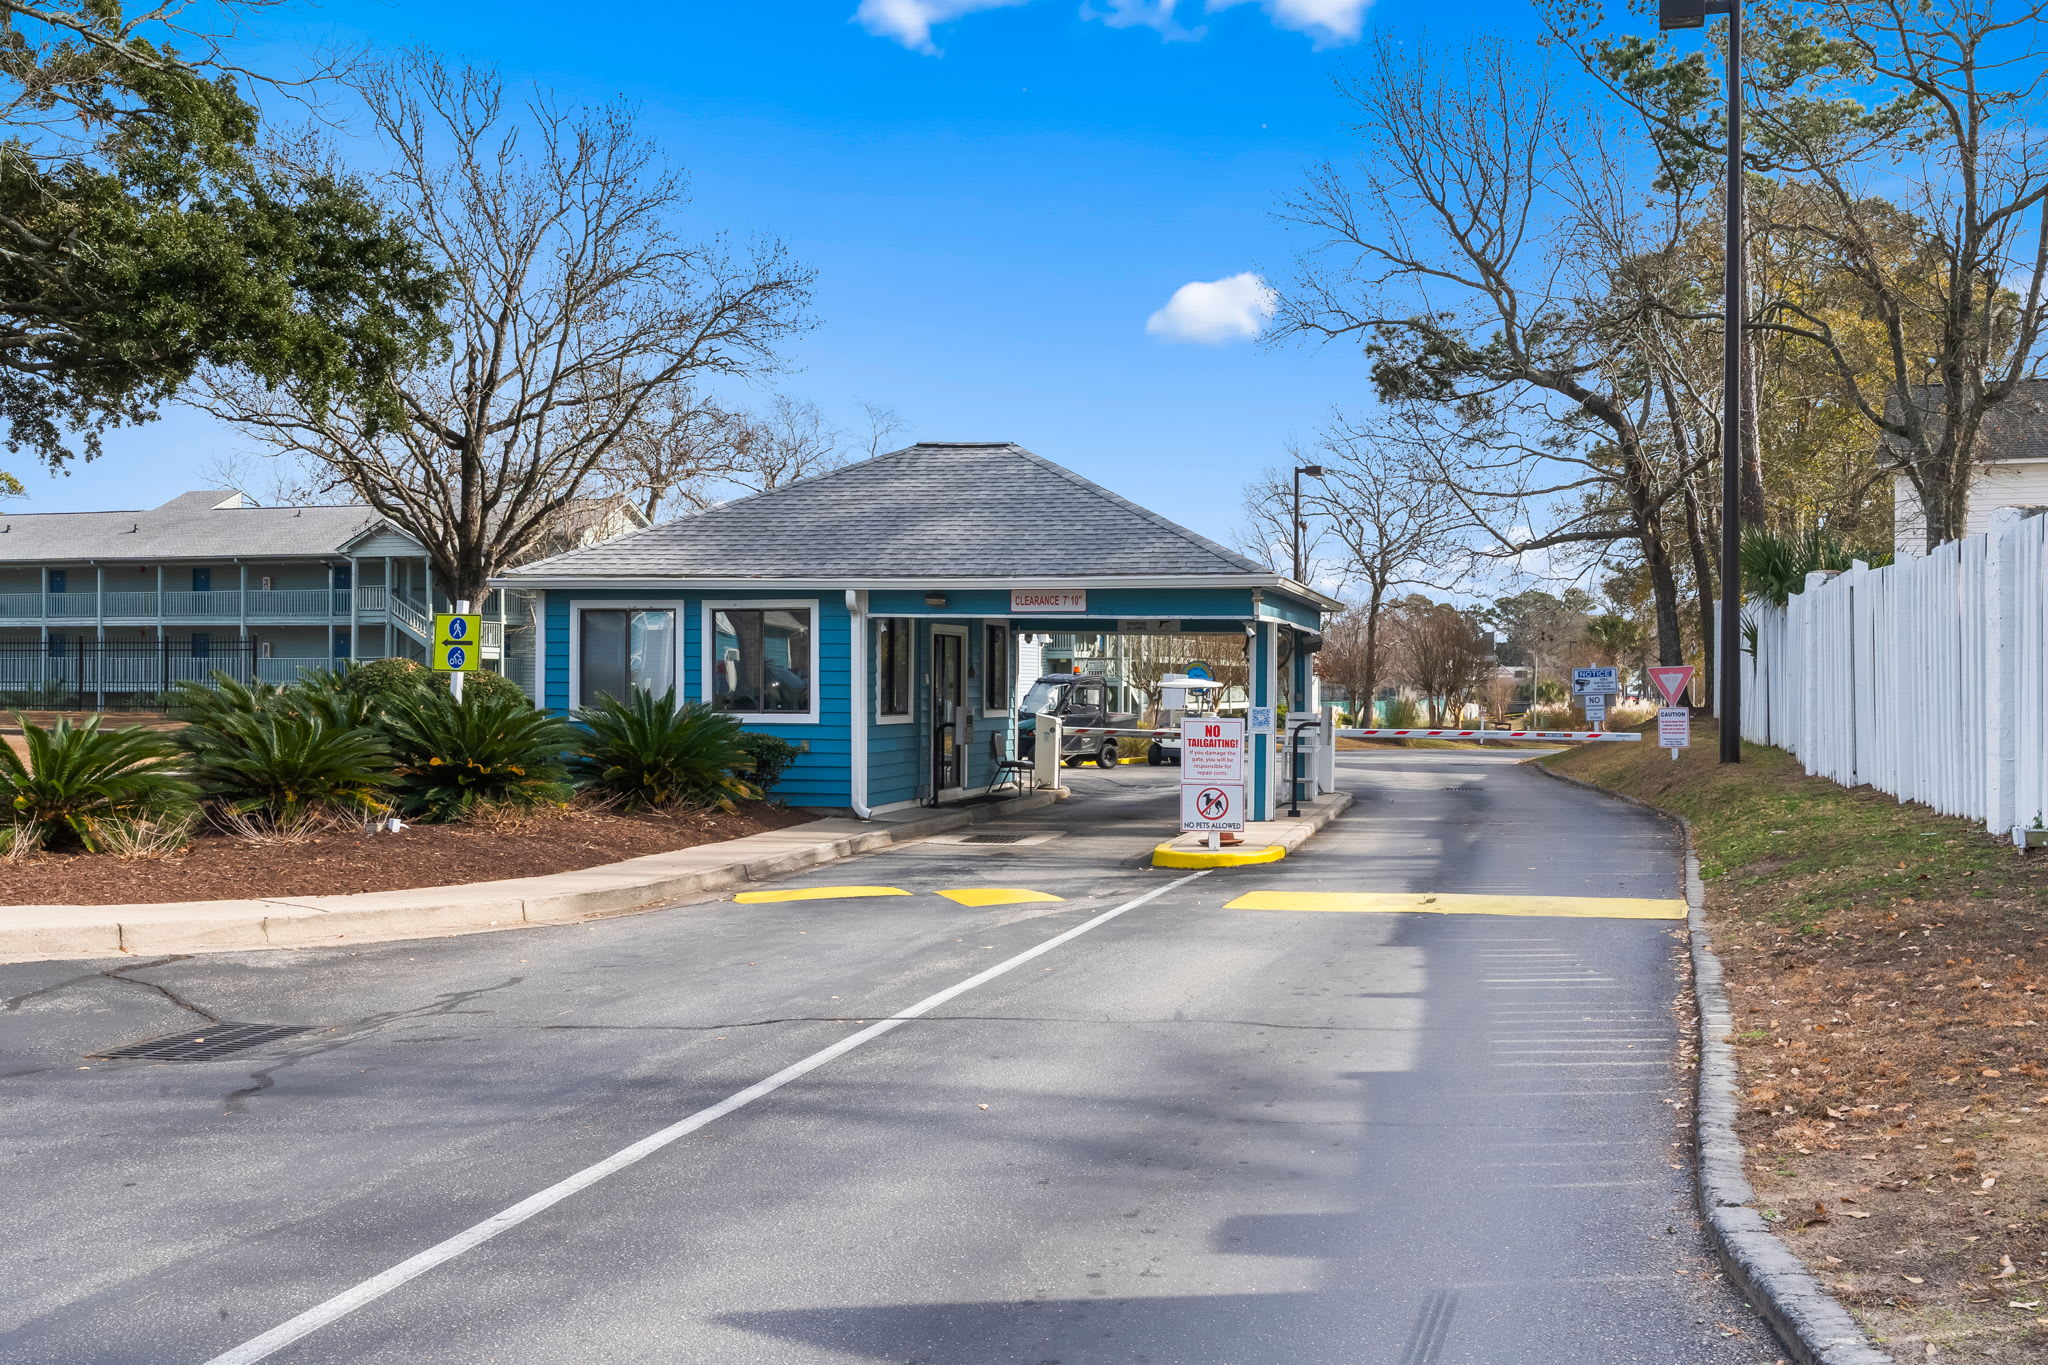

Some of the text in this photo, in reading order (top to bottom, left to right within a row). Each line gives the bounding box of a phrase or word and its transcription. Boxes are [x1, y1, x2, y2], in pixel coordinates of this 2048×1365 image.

[1015, 595, 1060, 606] CLEARANCE
[1205, 725, 1220, 737] NO
[1187, 738, 1238, 748] TAILGAITING!
[1211, 822, 1241, 830] ALLOWED
